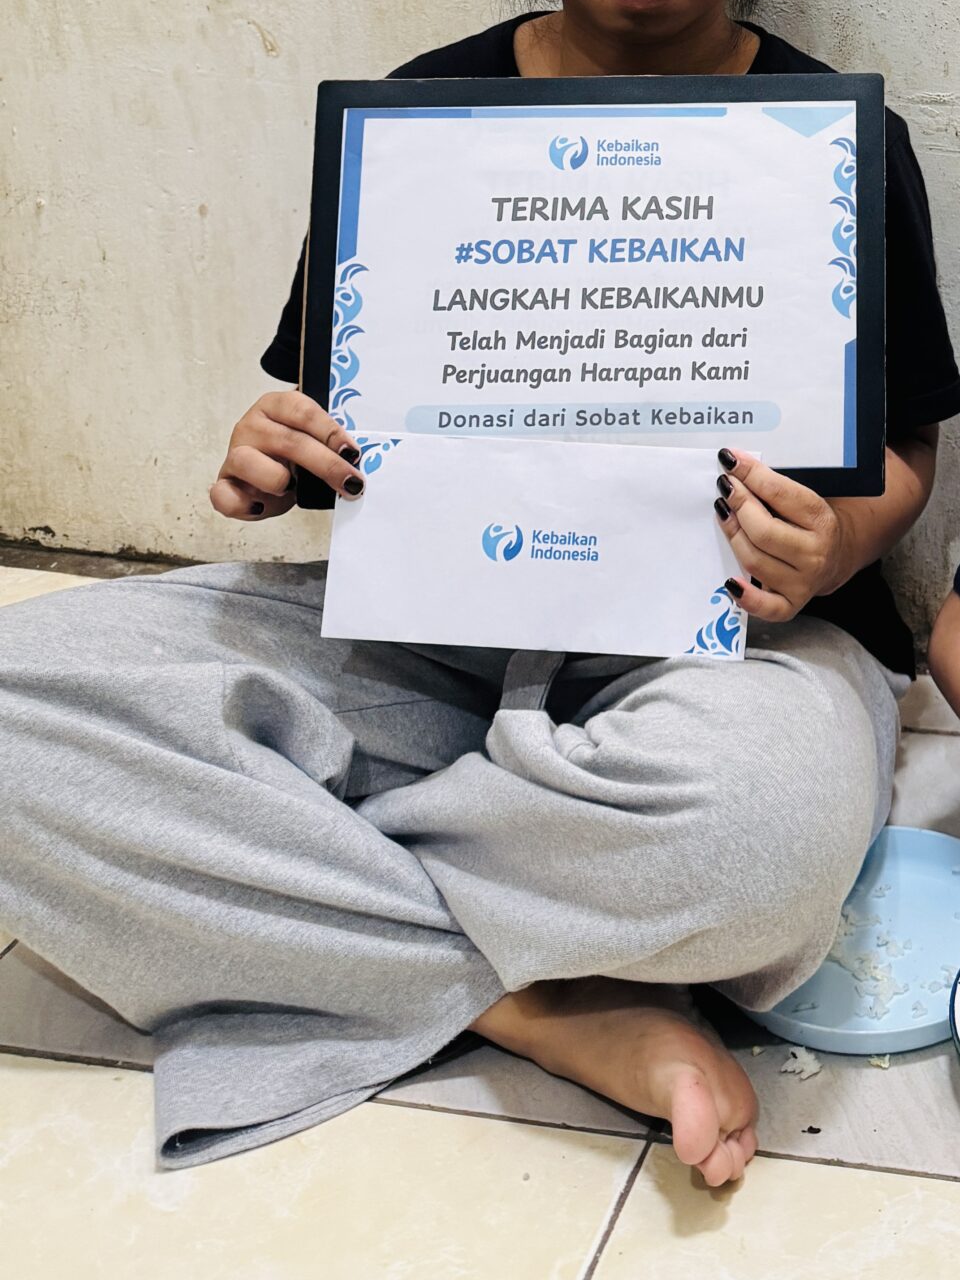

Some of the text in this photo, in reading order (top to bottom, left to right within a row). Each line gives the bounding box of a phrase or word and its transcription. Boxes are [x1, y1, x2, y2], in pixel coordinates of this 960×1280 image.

[596, 138, 660, 153] Kebaikan
[596, 153, 662, 167] Indonesia
[491, 195, 714, 223] TERIMA KASIH
[454, 236, 746, 265] #SOBAT KEBAIKAN
[432, 285, 764, 312] LANGKAH KEBAIKANMU
[446, 326, 748, 356] Telah Menjadi Bagian dari
[441, 359, 750, 390] Perjuangan Harapan Kami
[438, 405, 754, 429] Donasi dari Sobat Kebaikan
[531, 529, 598, 546] Kebaikan
[530, 545, 599, 562] Indonesia
